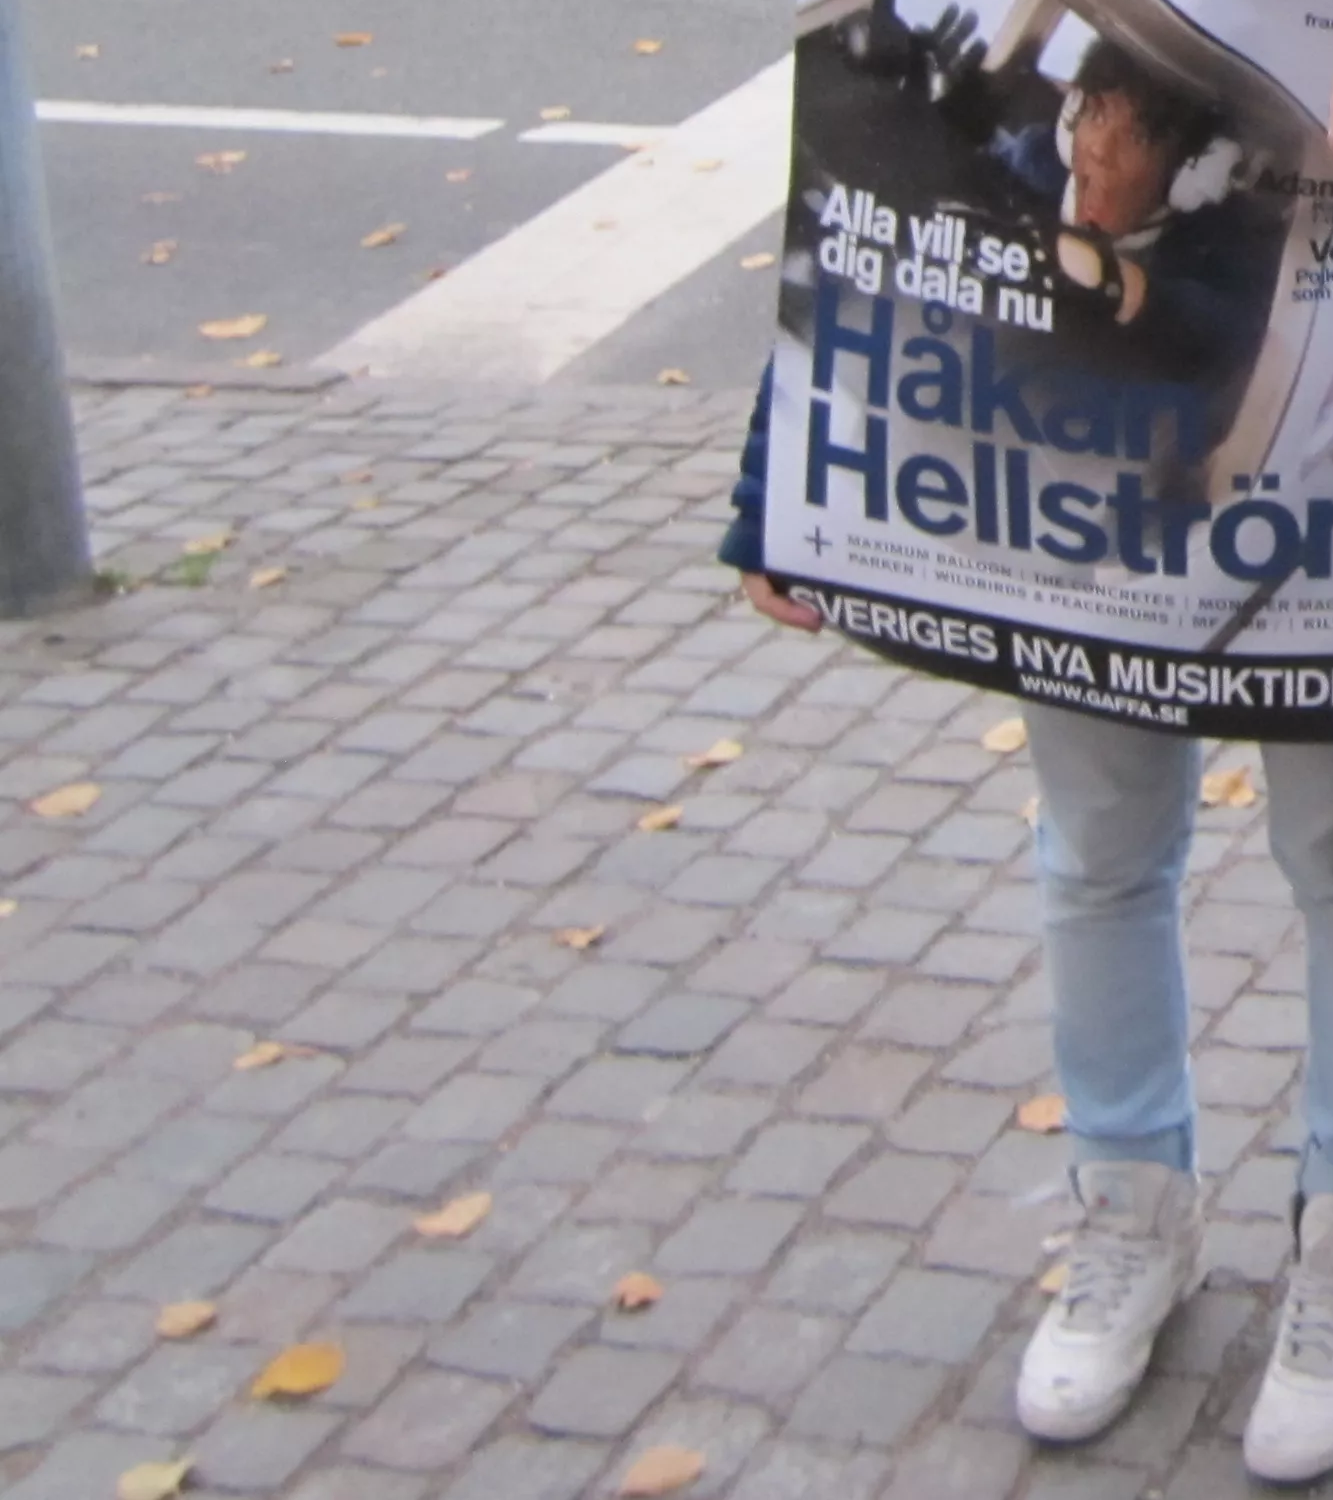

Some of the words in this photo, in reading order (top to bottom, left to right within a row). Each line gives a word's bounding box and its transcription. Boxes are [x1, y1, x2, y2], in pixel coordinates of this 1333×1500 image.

[818, 183, 896, 245] Alla
[909, 211, 966, 263] vill
[981, 237, 1030, 283] se
[820, 233, 883, 294] dig
[895, 253, 982, 315] dala
[998, 282, 1054, 333] nu
[811, 284, 1202, 465] Håkan
[847, 533, 931, 559] MAXIMUM
[936, 550, 1013, 578] BALLOON
[1033, 572, 1065, 589] THE
[1070, 577, 1177, 608] CONCRETES
[847, 552, 915, 576] PARKEN
[933, 570, 1016, 598] WILDBIRDS
[1050, 593, 1170, 626] PEACEDRUMS
[787, 586, 999, 664] SVERIGES
[1011, 632, 1096, 684] NYA
[1020, 672, 1190, 728] WWW.GAFFA.SE
